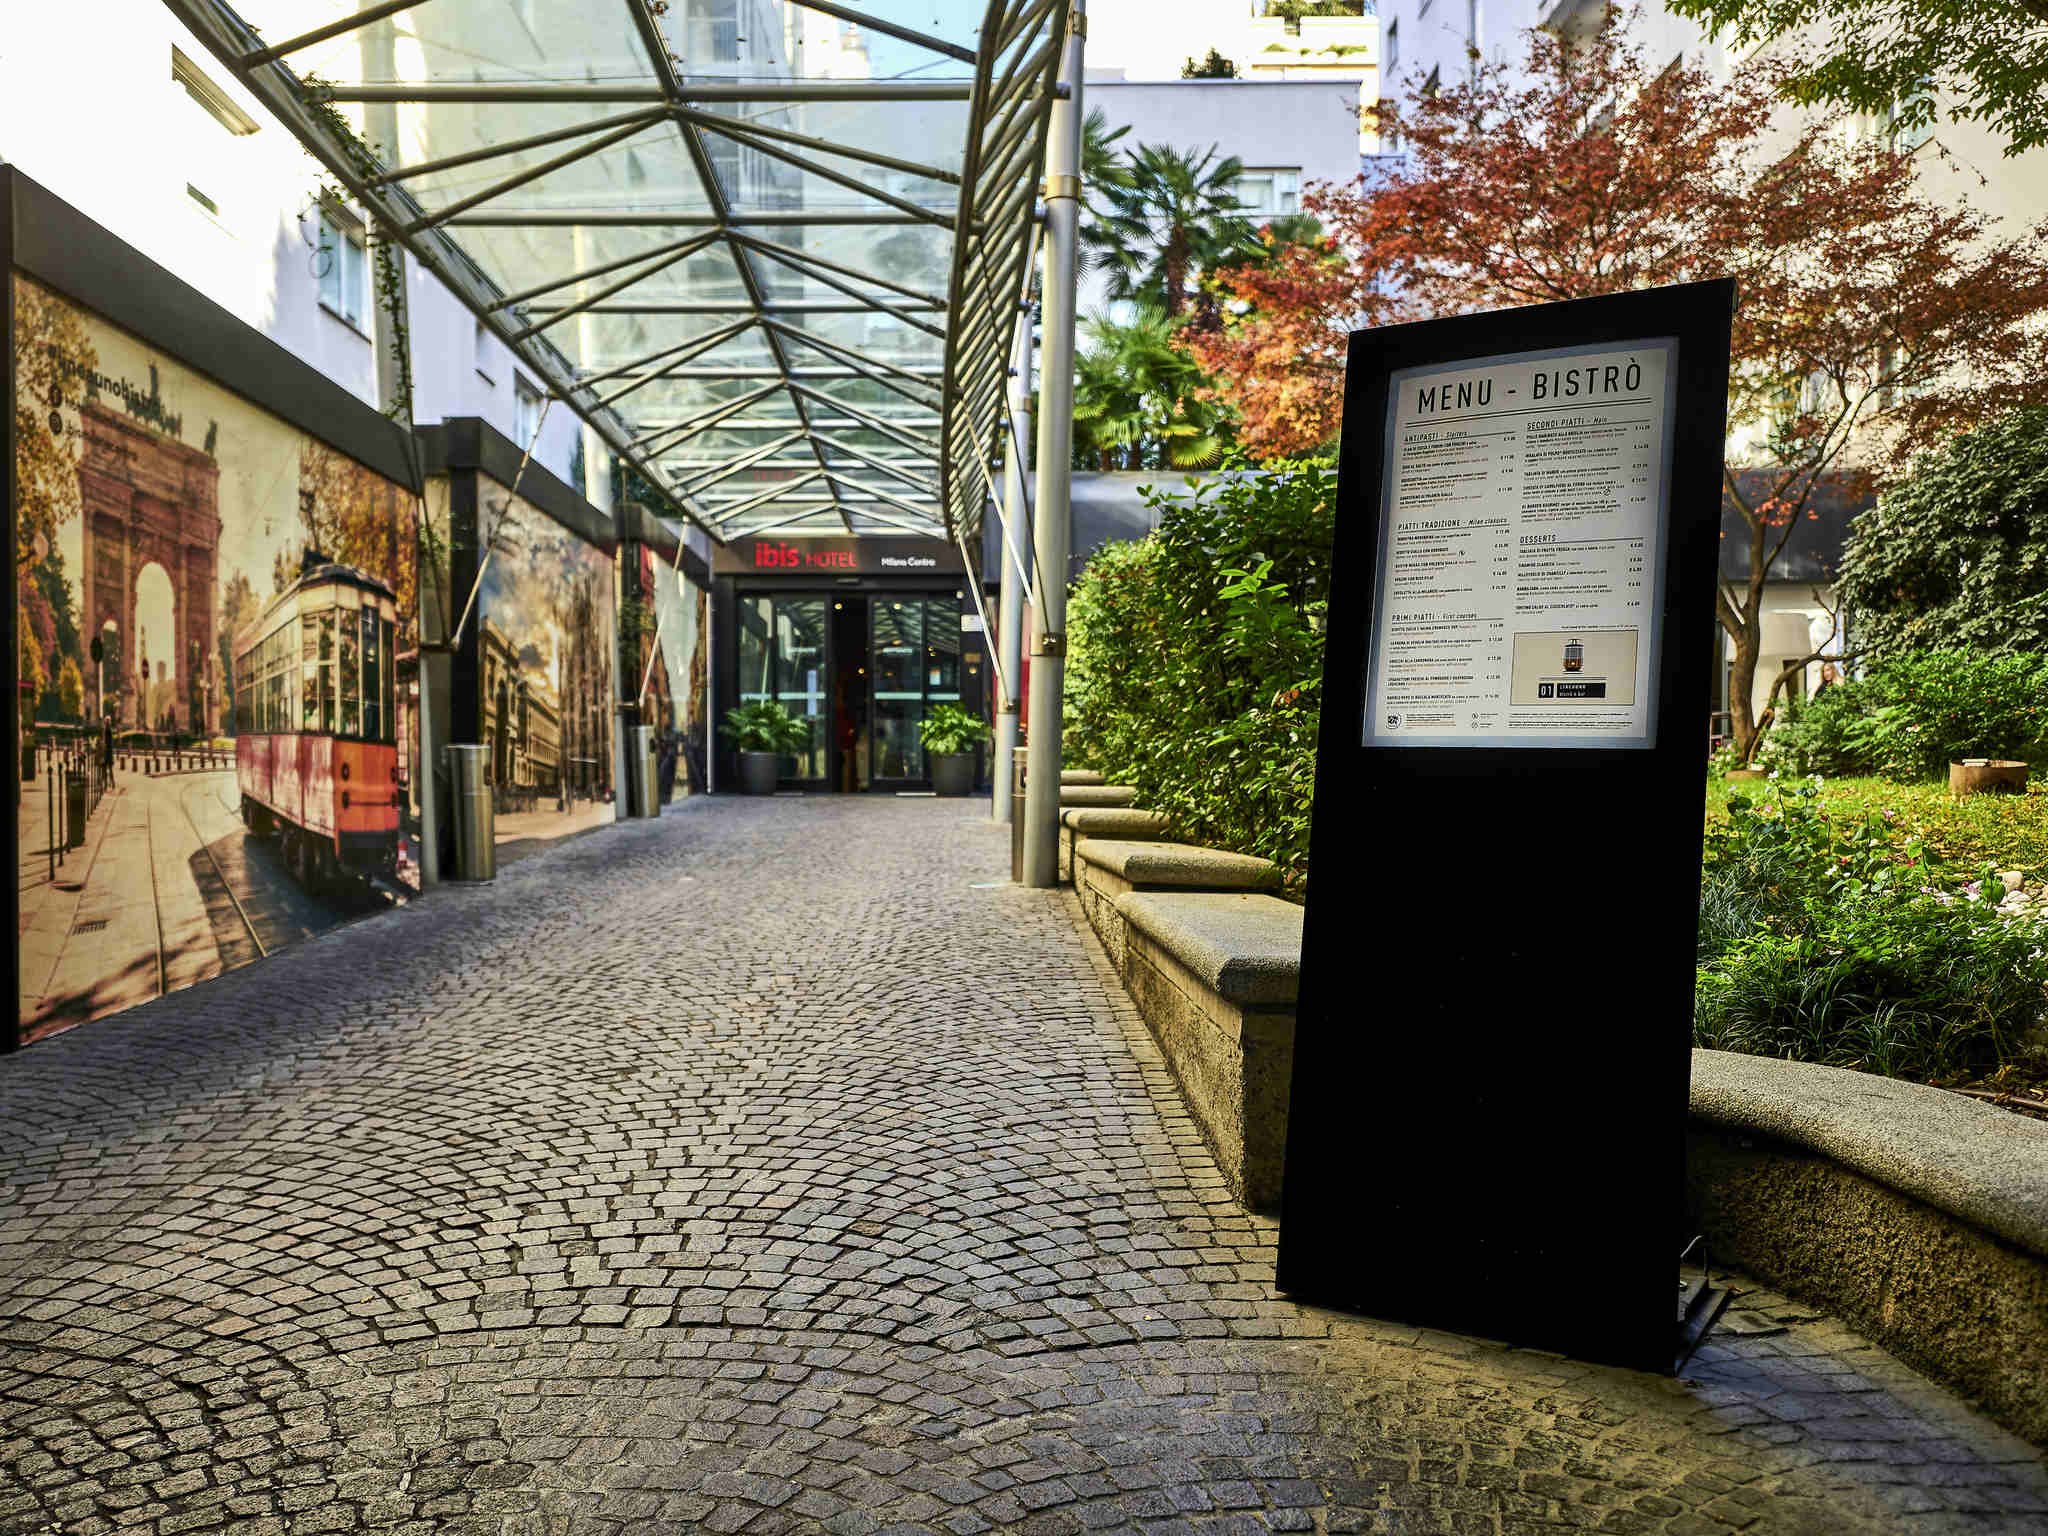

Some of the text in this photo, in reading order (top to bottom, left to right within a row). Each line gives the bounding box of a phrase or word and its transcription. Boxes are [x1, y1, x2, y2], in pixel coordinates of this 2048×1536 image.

[1418, 379, 1493, 414] MENU
[1533, 358, 1641, 400] BISTRÒ
[1527, 419, 1558, 430] SECONDI
[1561, 417, 1584, 427] PIATTI
[1405, 432, 1440, 441] ANTIPASTI
[1398, 522, 1419, 530] PIATTI
[1421, 519, 1460, 529] TRADIZIONE
[1520, 534, 1556, 544] DESSERTS
[755, 542, 857, 567] ibis HOTEL
[881, 557, 907, 566] Milano
[1541, 685, 1552, 696] 01
